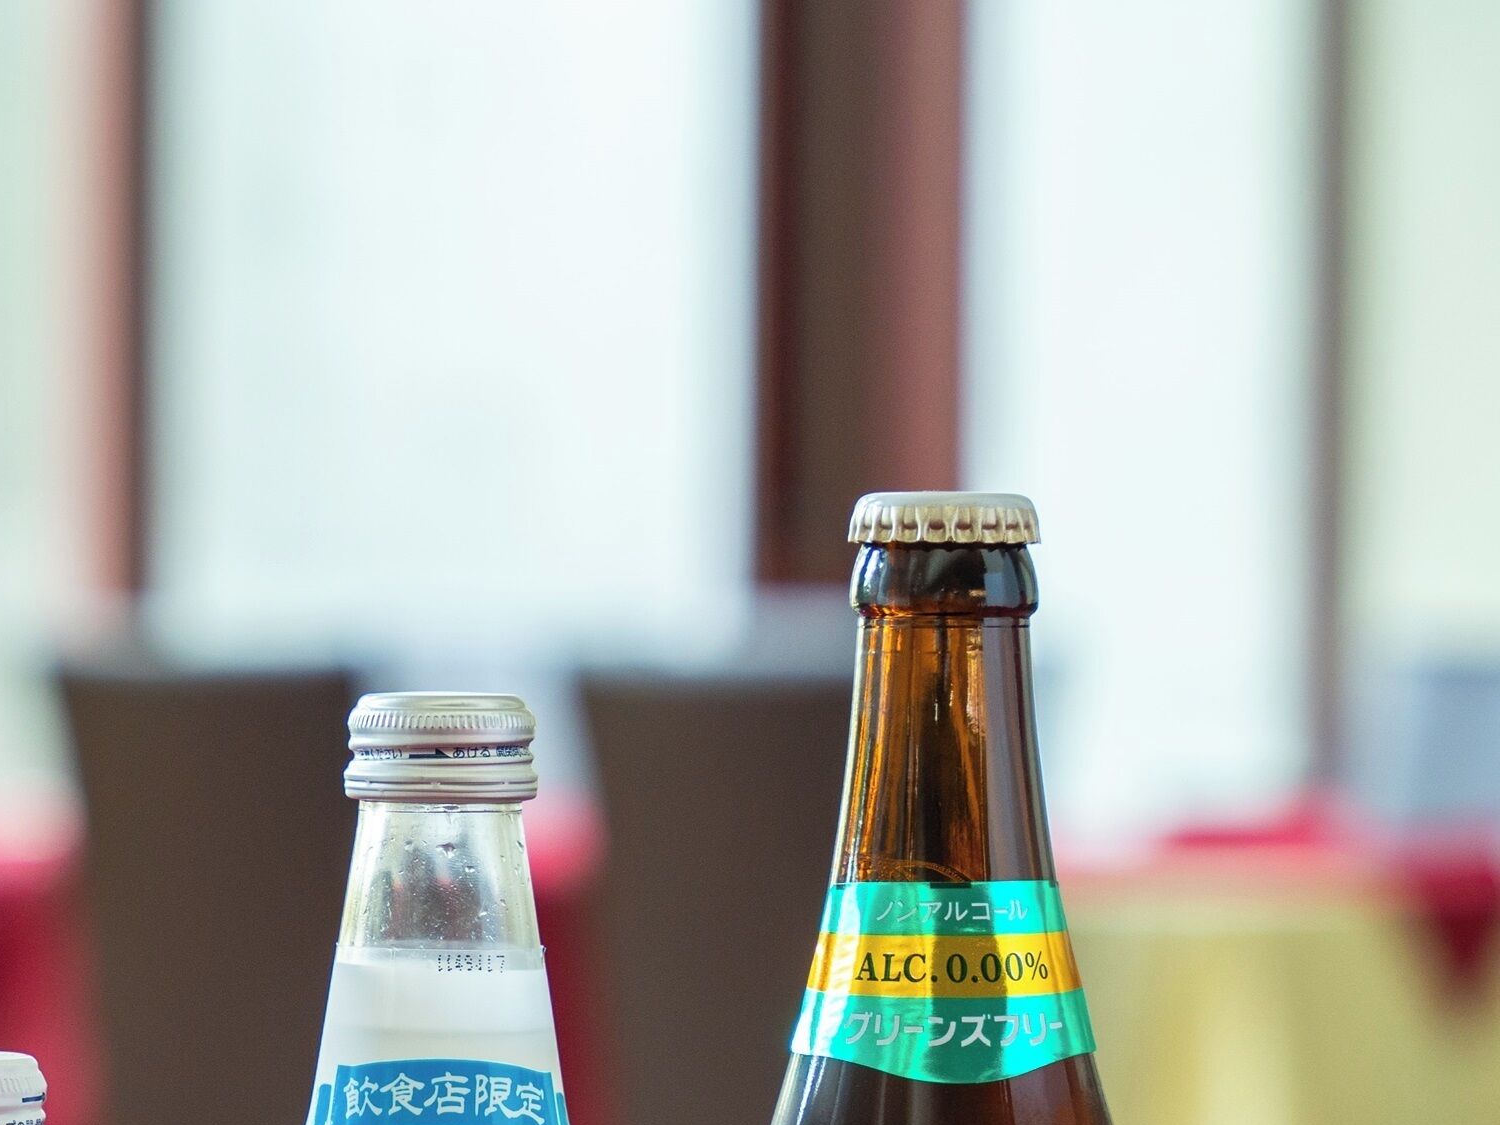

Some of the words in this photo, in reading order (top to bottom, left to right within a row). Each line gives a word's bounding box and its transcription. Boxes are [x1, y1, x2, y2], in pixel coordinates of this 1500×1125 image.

[876, 899, 1028, 923] ノンアルコール
[855, 951, 938, 983] ALC.
[946, 950, 1049, 983] 0.00%
[844, 1011, 1062, 1048] グリーンズフリー
[343, 1071, 546, 1125] 飲食店限定
